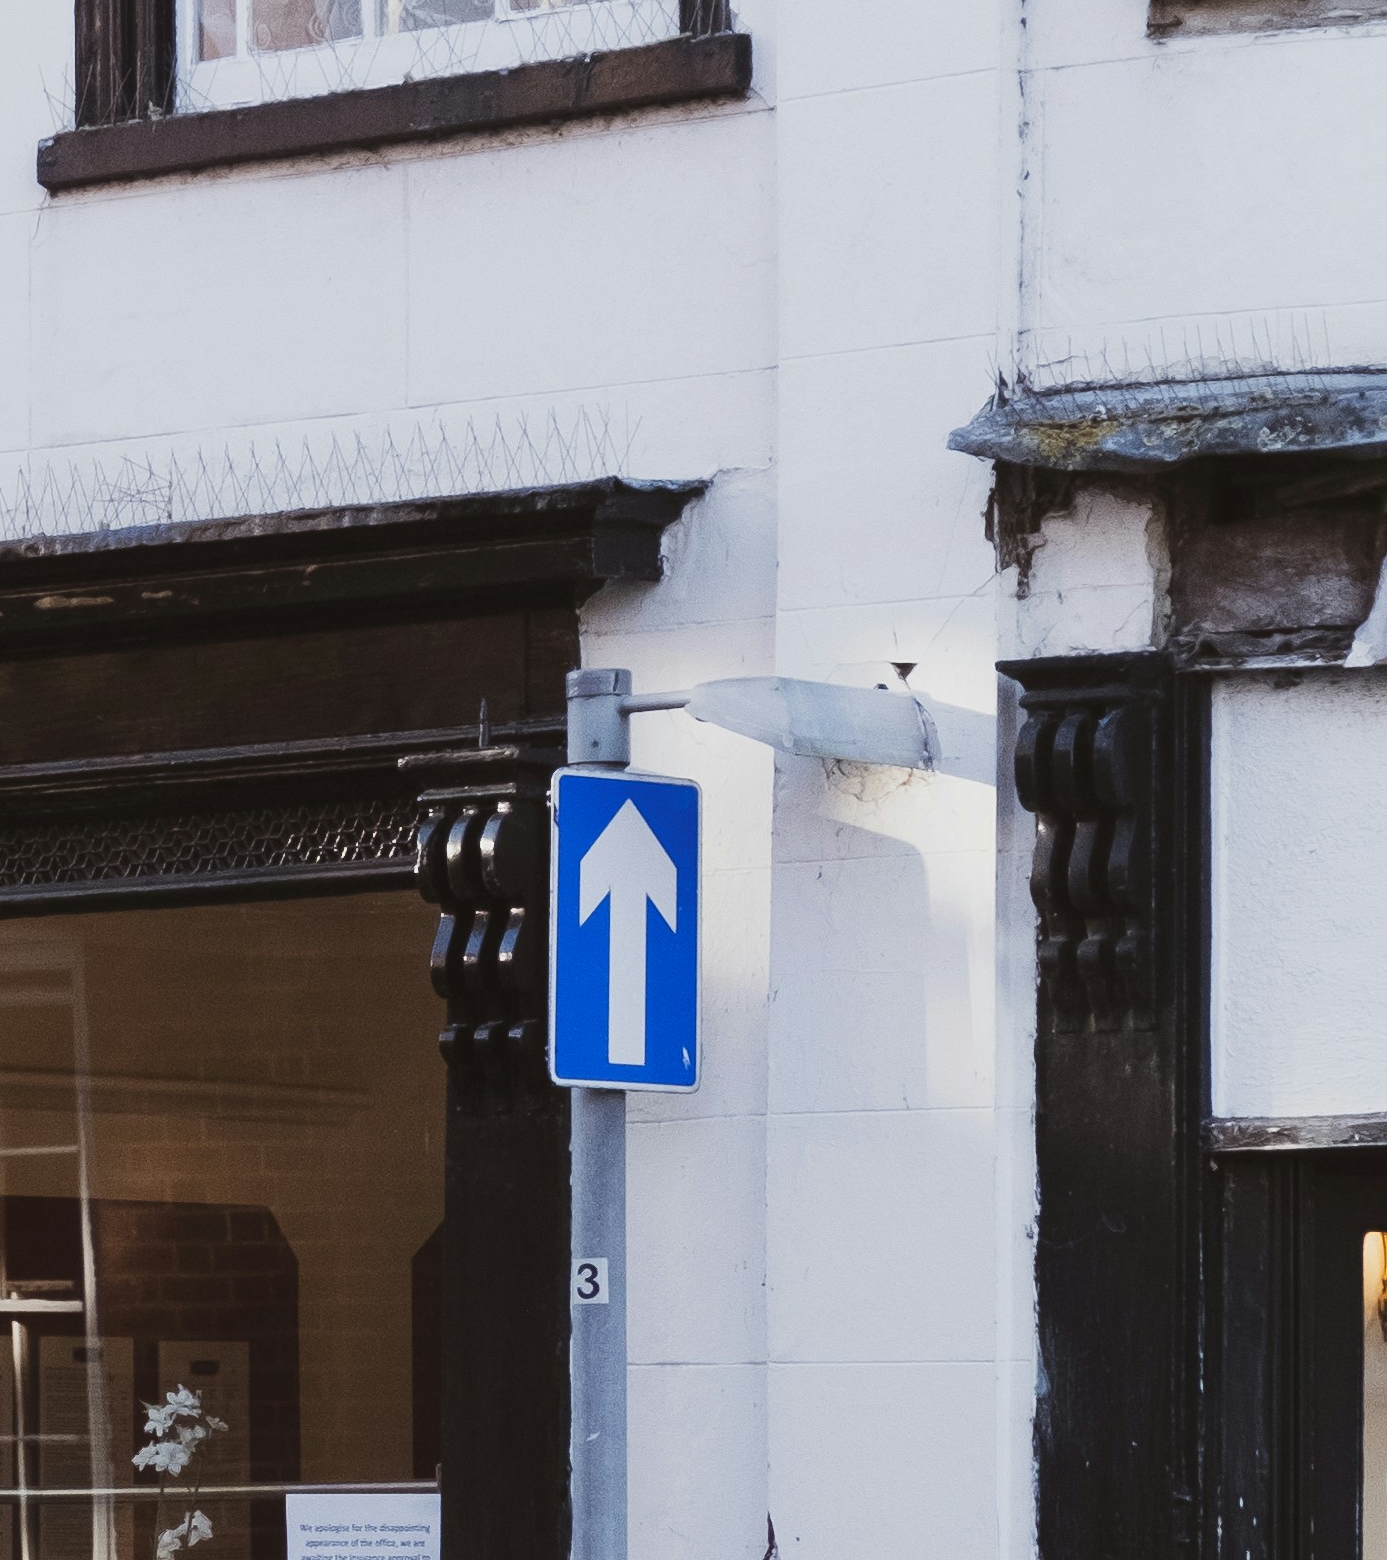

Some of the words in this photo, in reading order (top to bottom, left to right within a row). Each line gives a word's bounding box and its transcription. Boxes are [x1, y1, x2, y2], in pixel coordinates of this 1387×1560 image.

[577, 1263, 600, 1300] 3
[351, 1524, 363, 1532] for
[365, 1524, 378, 1533] the
[350, 1538, 359, 1547] of
[360, 1539, 373, 1547] the
